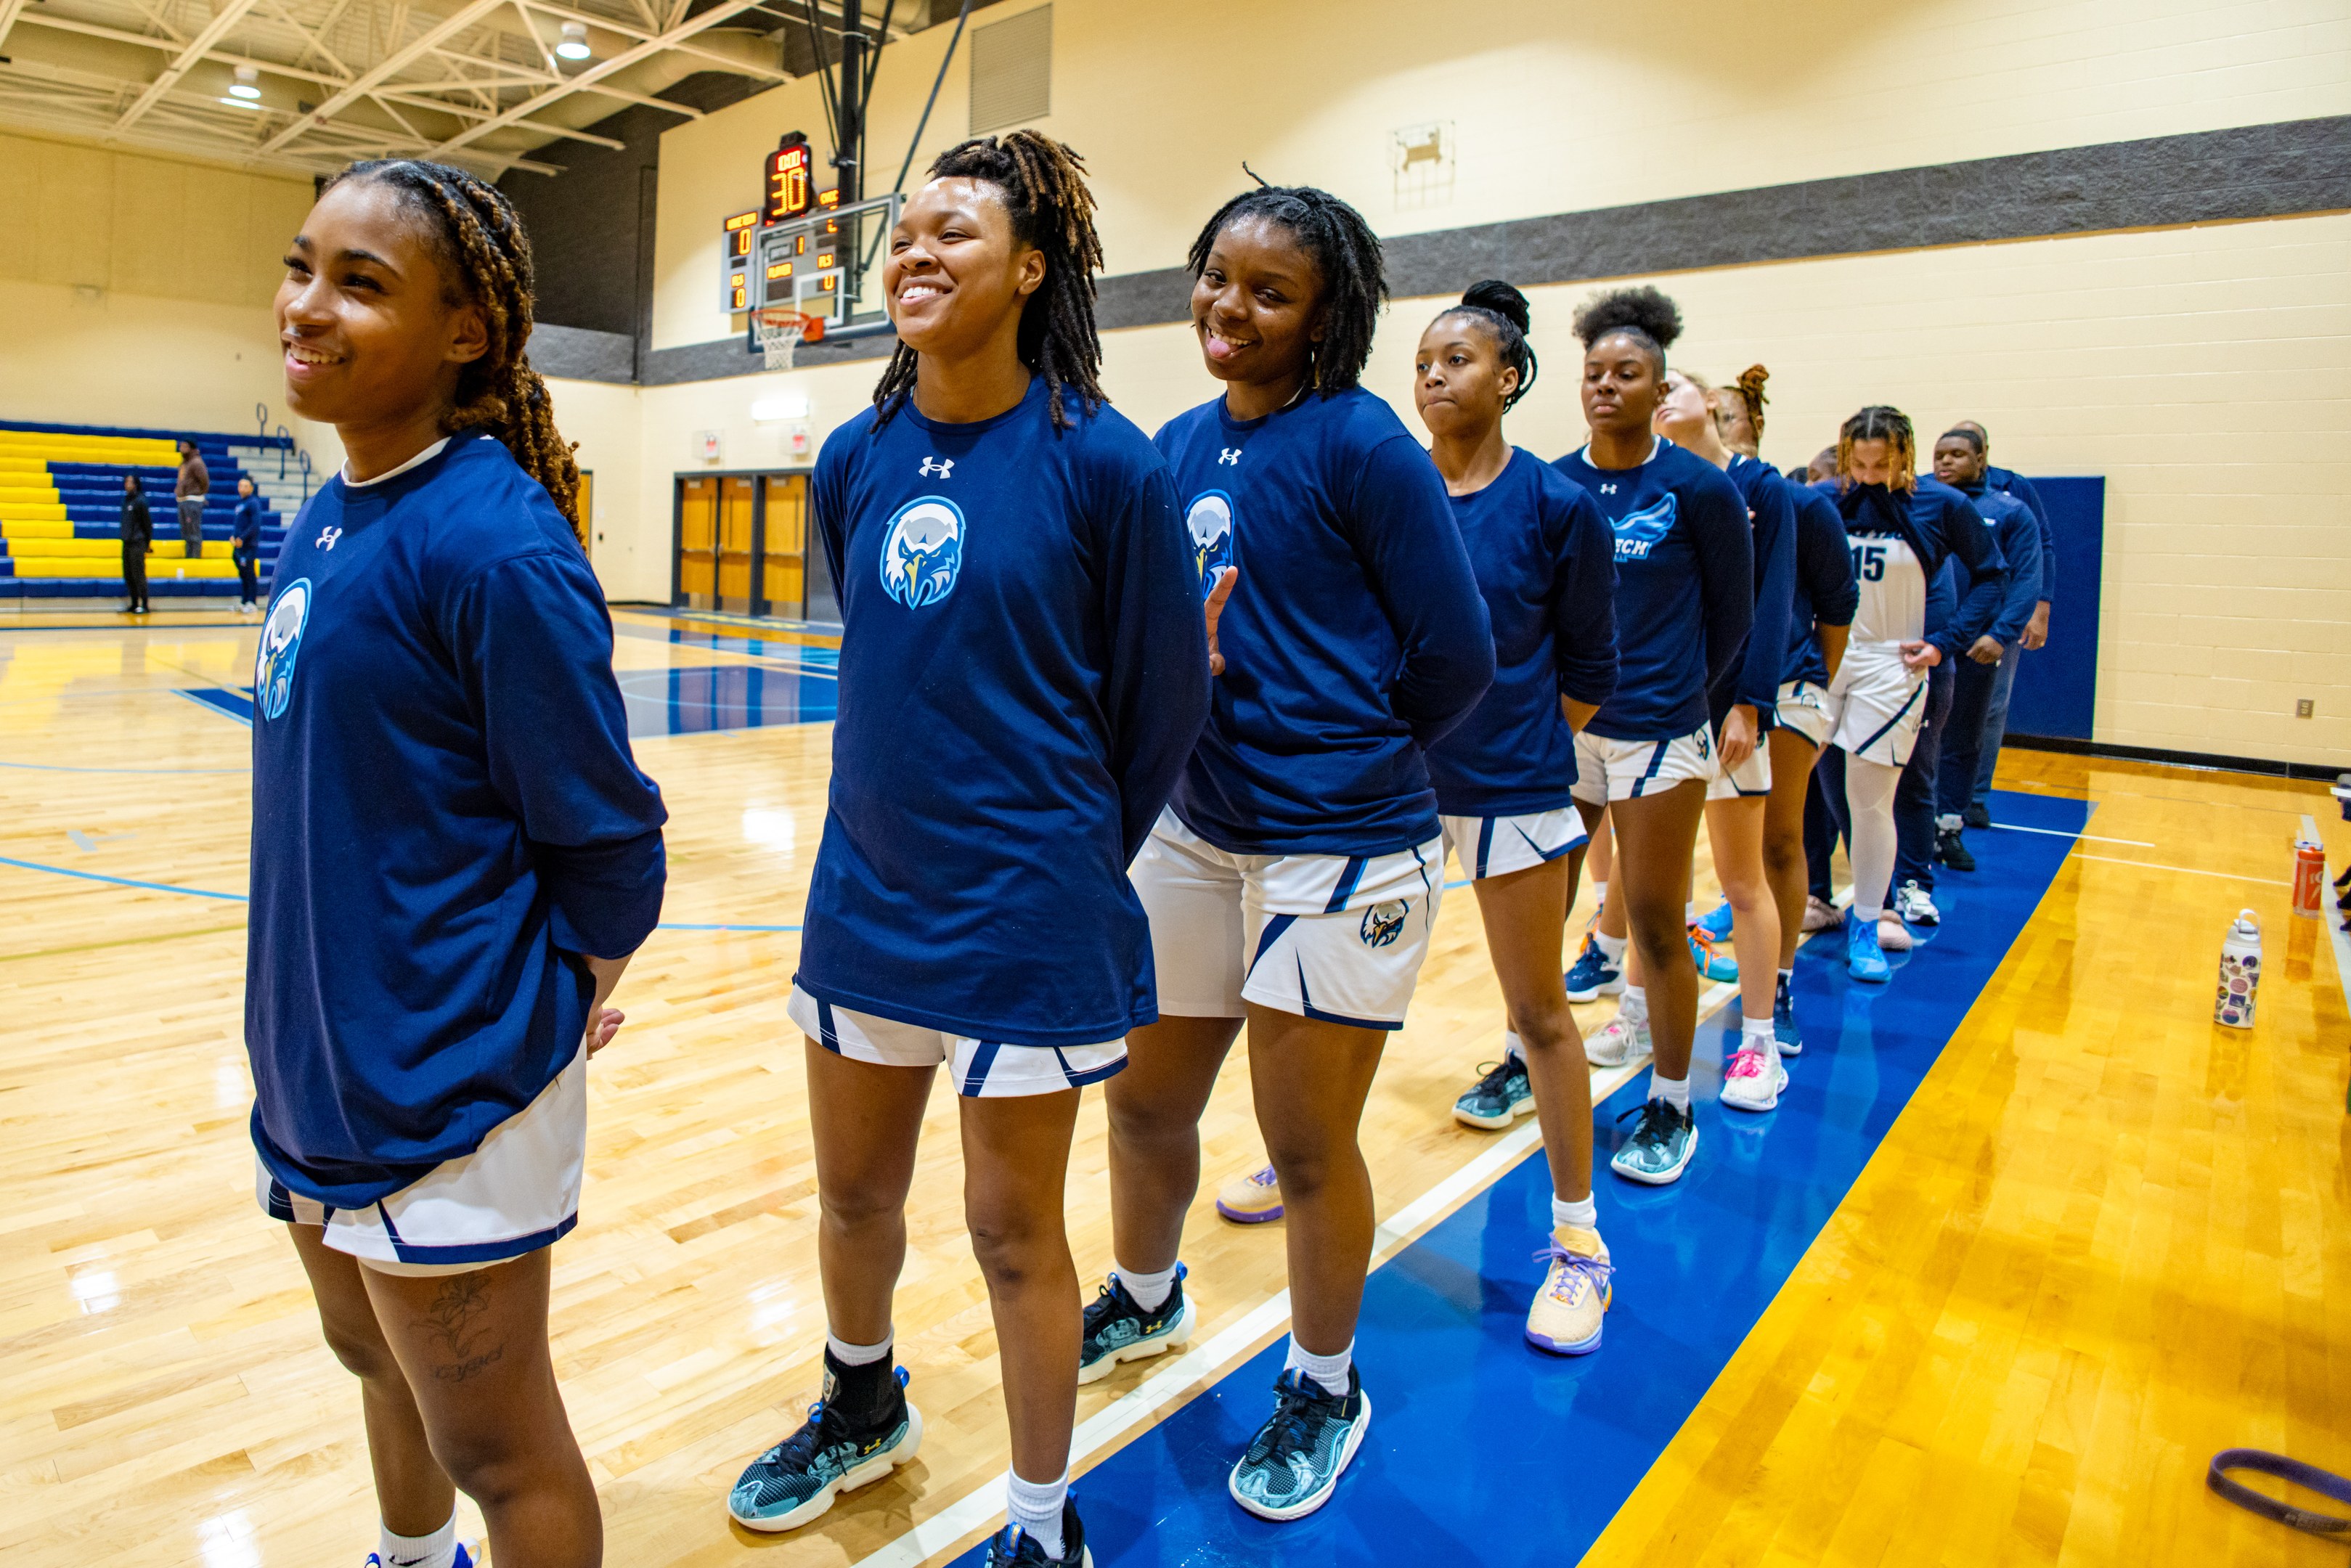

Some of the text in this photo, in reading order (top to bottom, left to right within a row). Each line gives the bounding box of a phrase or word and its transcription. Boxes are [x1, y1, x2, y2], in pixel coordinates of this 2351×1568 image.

[771, 167, 804, 216] 30
[739, 228, 751, 255] 0
[736, 287, 745, 308] 0
[1851, 545, 1887, 582] 15
